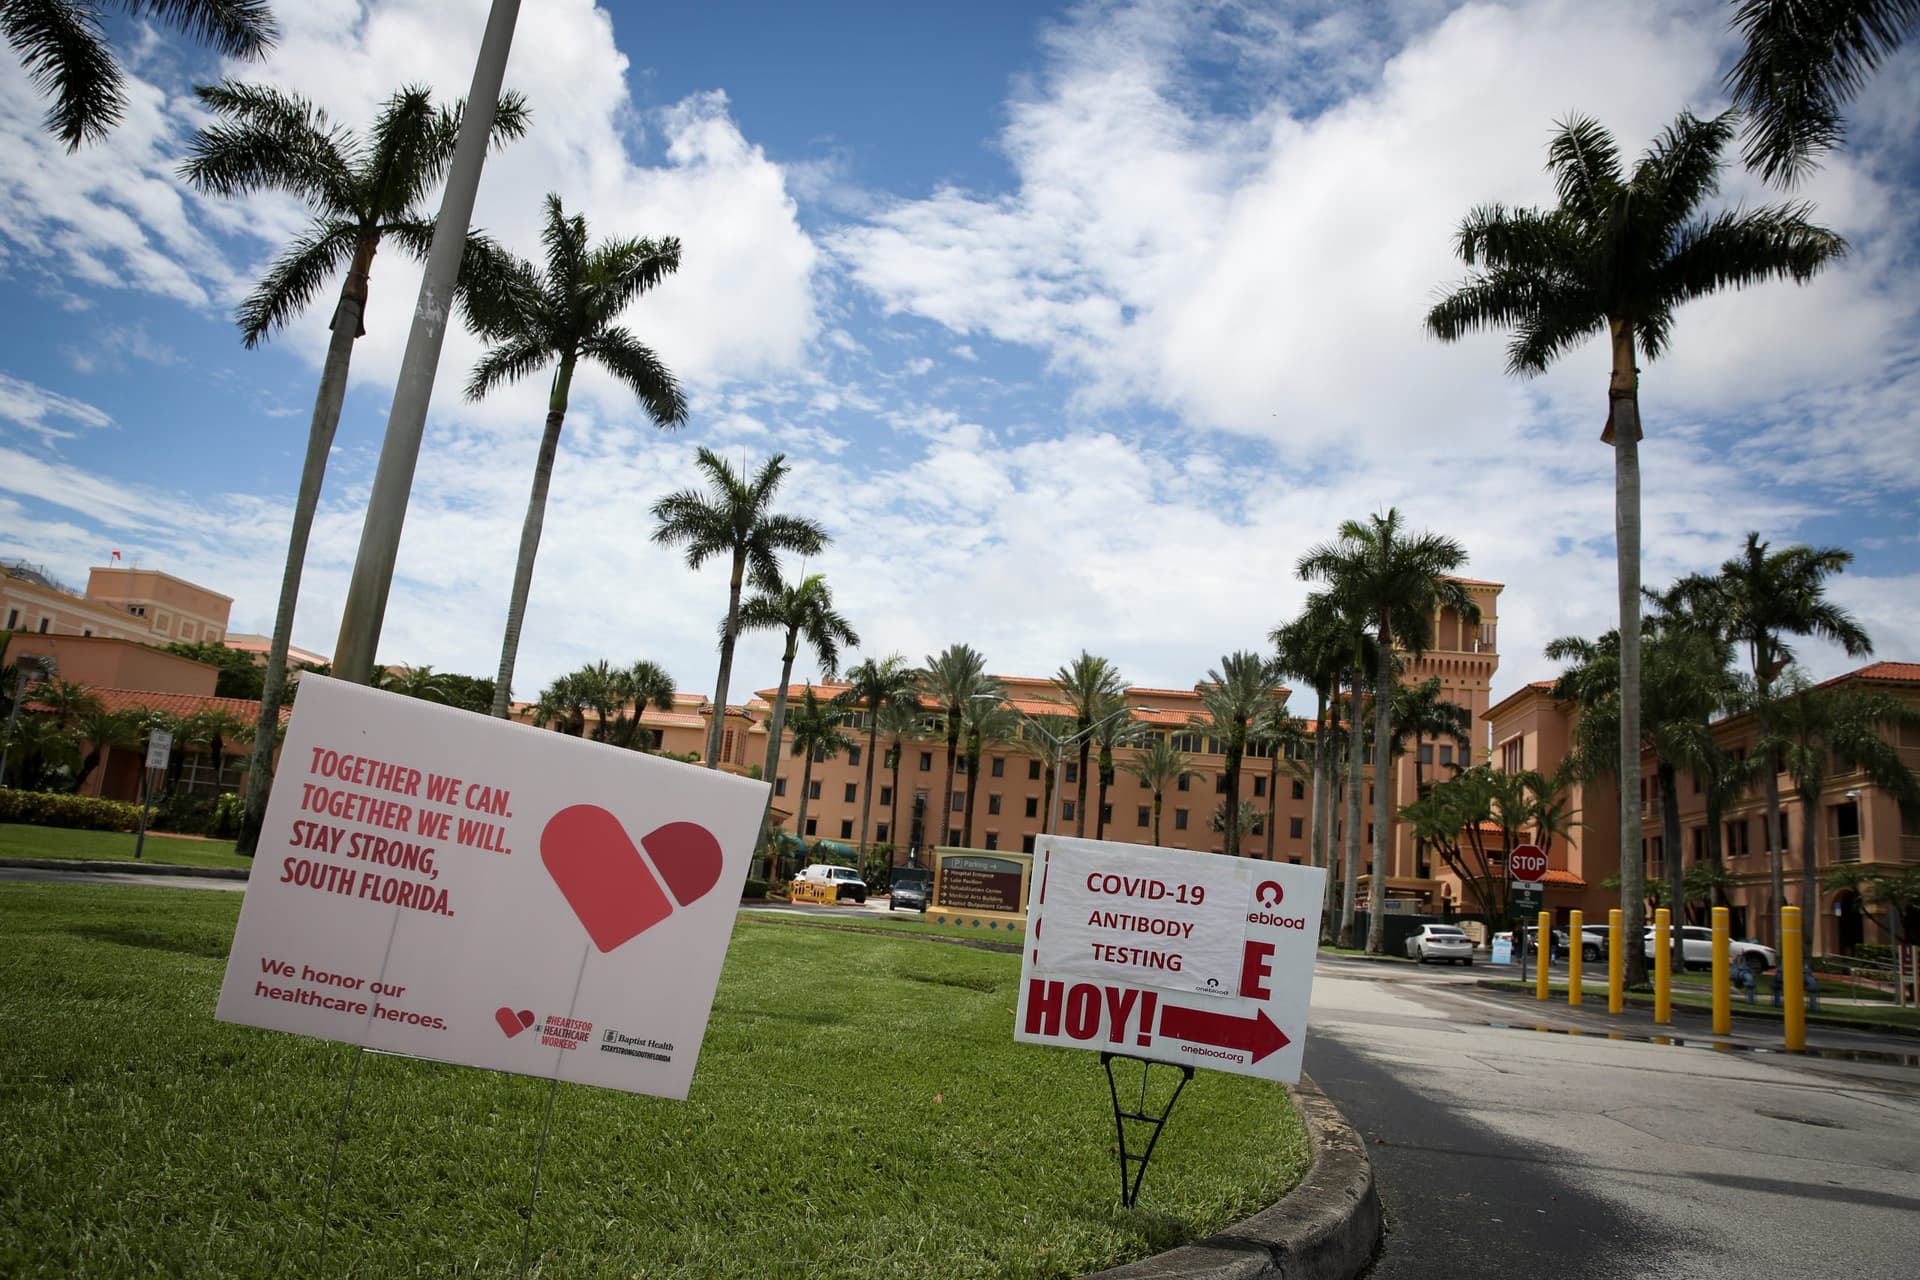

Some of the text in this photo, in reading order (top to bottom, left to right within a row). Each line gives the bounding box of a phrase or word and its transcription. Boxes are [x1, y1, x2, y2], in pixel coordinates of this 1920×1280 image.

[310, 746, 512, 818] TOGETHER WE CAN.
[301, 783, 512, 855] TOGETHER WE WILL.
[289, 820, 439, 881] STAY STRONG,
[1512, 855, 1545, 871] STOP
[280, 857, 454, 917] SOUTH FLORIDA.
[1087, 872, 1205, 905] COVID-19
[1088, 910, 1195, 939] ANTIBODY
[1246, 912, 1305, 930] eblood
[1091, 943, 1183, 972] TESTING
[261, 957, 406, 998] We honor our
[1195, 986, 1229, 996] oneblood
[255, 981, 448, 1031] healthcare heroes.
[1024, 978, 1158, 1047] HOY!
[543, 1025, 590, 1042] HEALTHCARE
[546, 1015, 593, 1031] #HEARTSFOR
[541, 1036, 577, 1050] WORKERS
[618, 1034, 674, 1051] Baptist Health
[1181, 1044, 1244, 1064] oneblood.org
